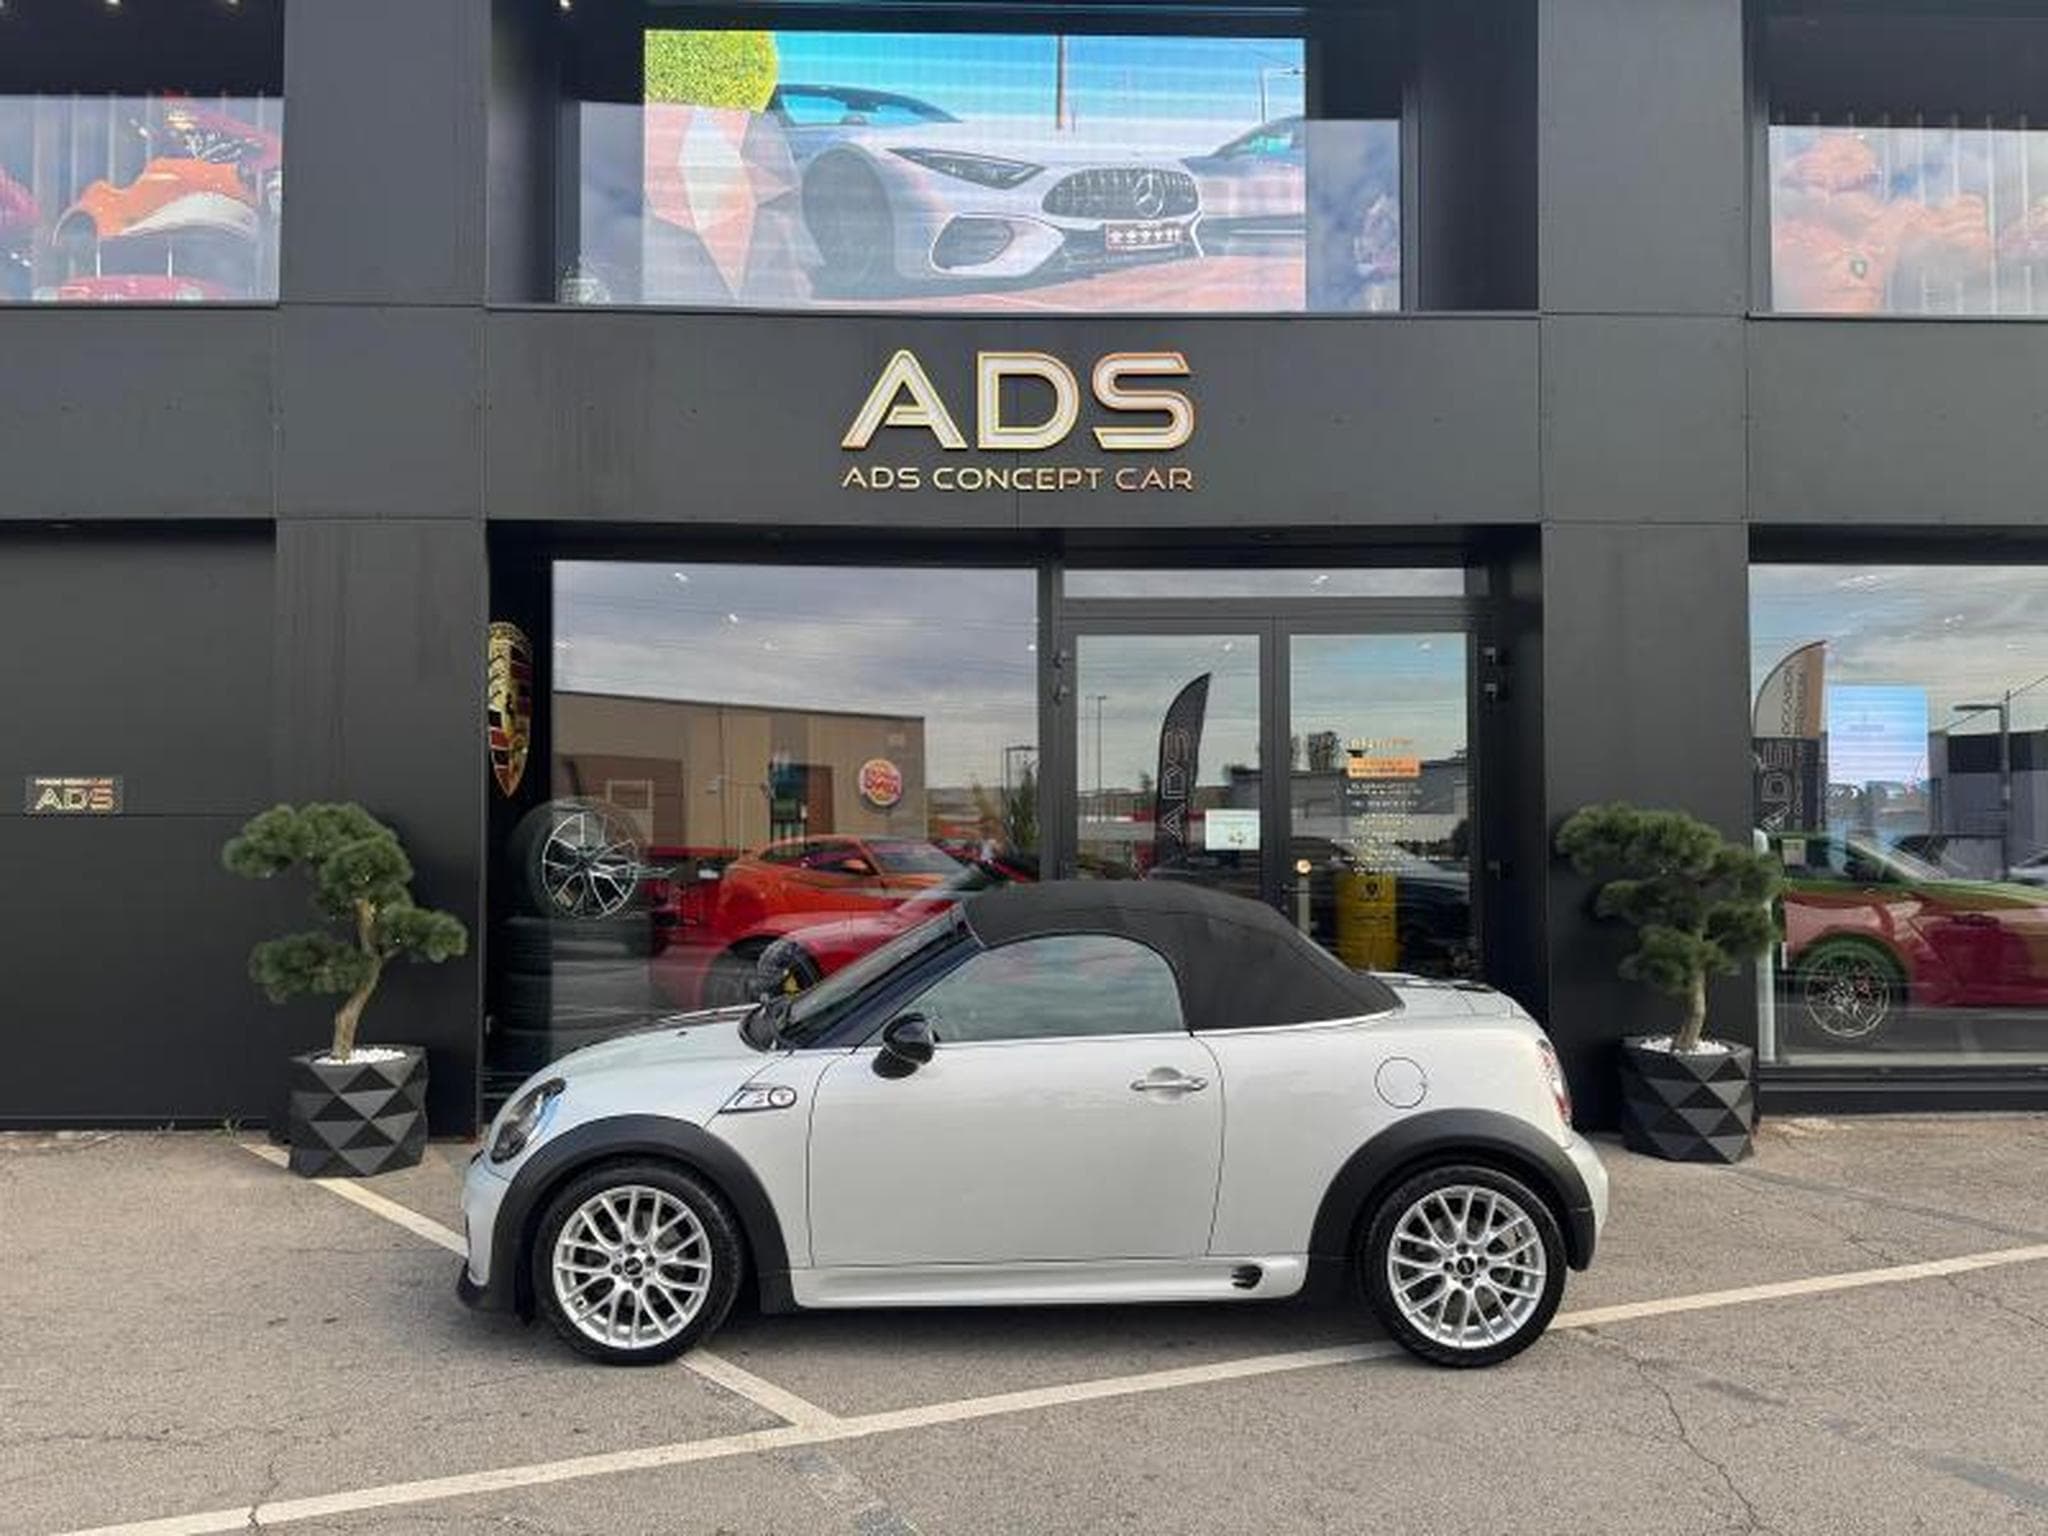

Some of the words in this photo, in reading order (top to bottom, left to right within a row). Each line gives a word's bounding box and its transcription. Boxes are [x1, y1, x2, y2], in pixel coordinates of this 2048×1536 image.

[840, 349, 1196, 450] ADS
[842, 466, 921, 489] ADS
[933, 466, 1103, 490] CONCEPT
[1115, 467, 1194, 490] CAR
[34, 787, 113, 810] ADS
[1160, 728, 1191, 845] ADS
